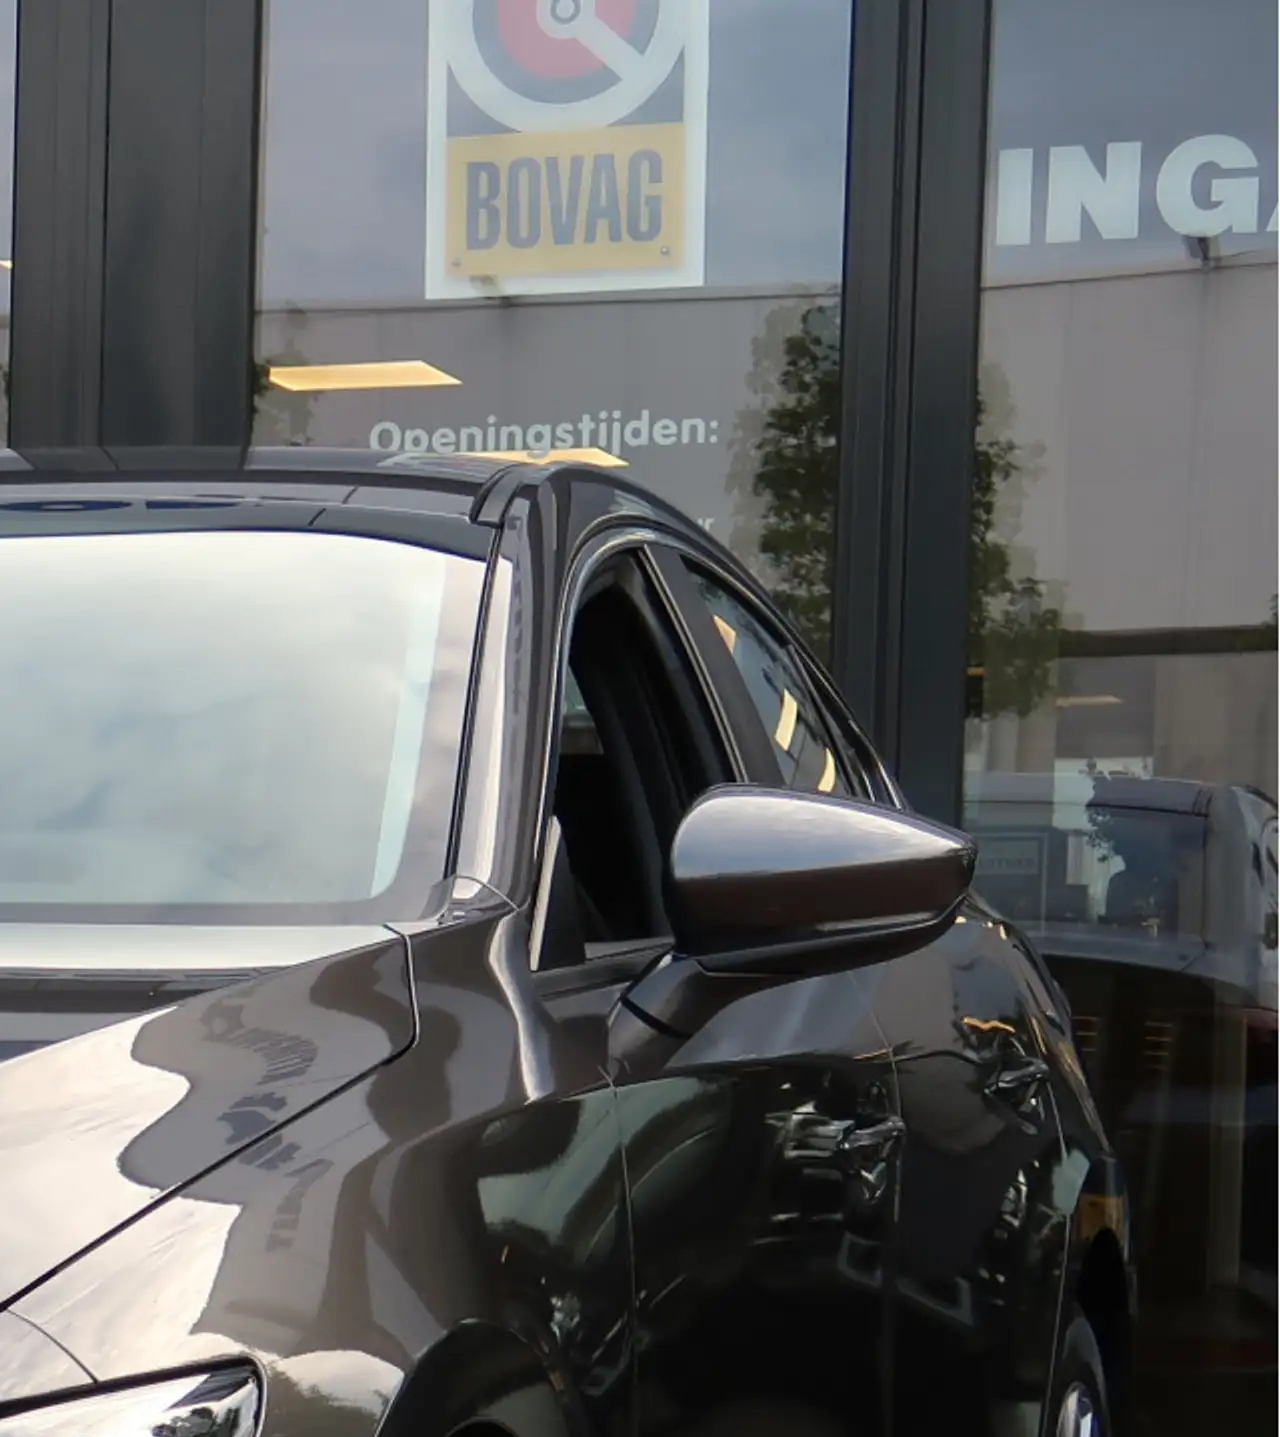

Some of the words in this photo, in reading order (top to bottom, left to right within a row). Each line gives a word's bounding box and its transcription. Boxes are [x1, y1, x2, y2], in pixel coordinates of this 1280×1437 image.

[466, 149, 663, 251] BOVAG
[996, 134, 1278, 246] ING
[369, 409, 721, 458] Openingstijden:
